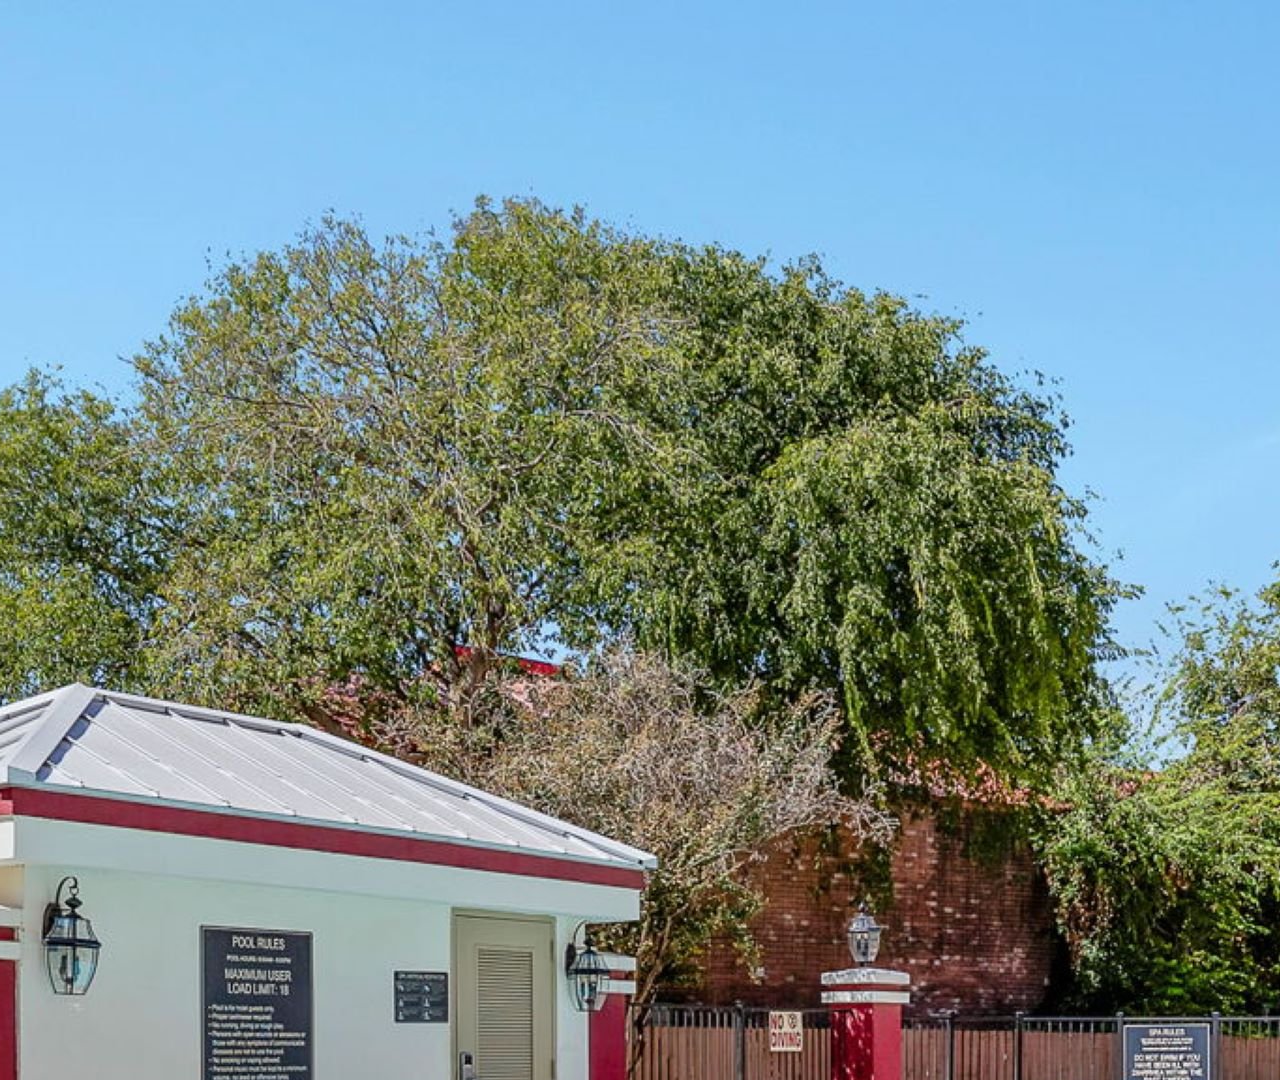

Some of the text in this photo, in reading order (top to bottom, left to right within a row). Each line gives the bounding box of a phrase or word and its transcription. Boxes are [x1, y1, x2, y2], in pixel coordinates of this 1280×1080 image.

[232, 935, 285, 950] POOL RULES
[225, 968, 292, 982] MAXIMUM USER
[227, 982, 251, 994] LOAD
[253, 983, 279, 995] LIMIT:
[770, 1014, 784, 1030] NO
[771, 1032, 801, 1048] DIVING
